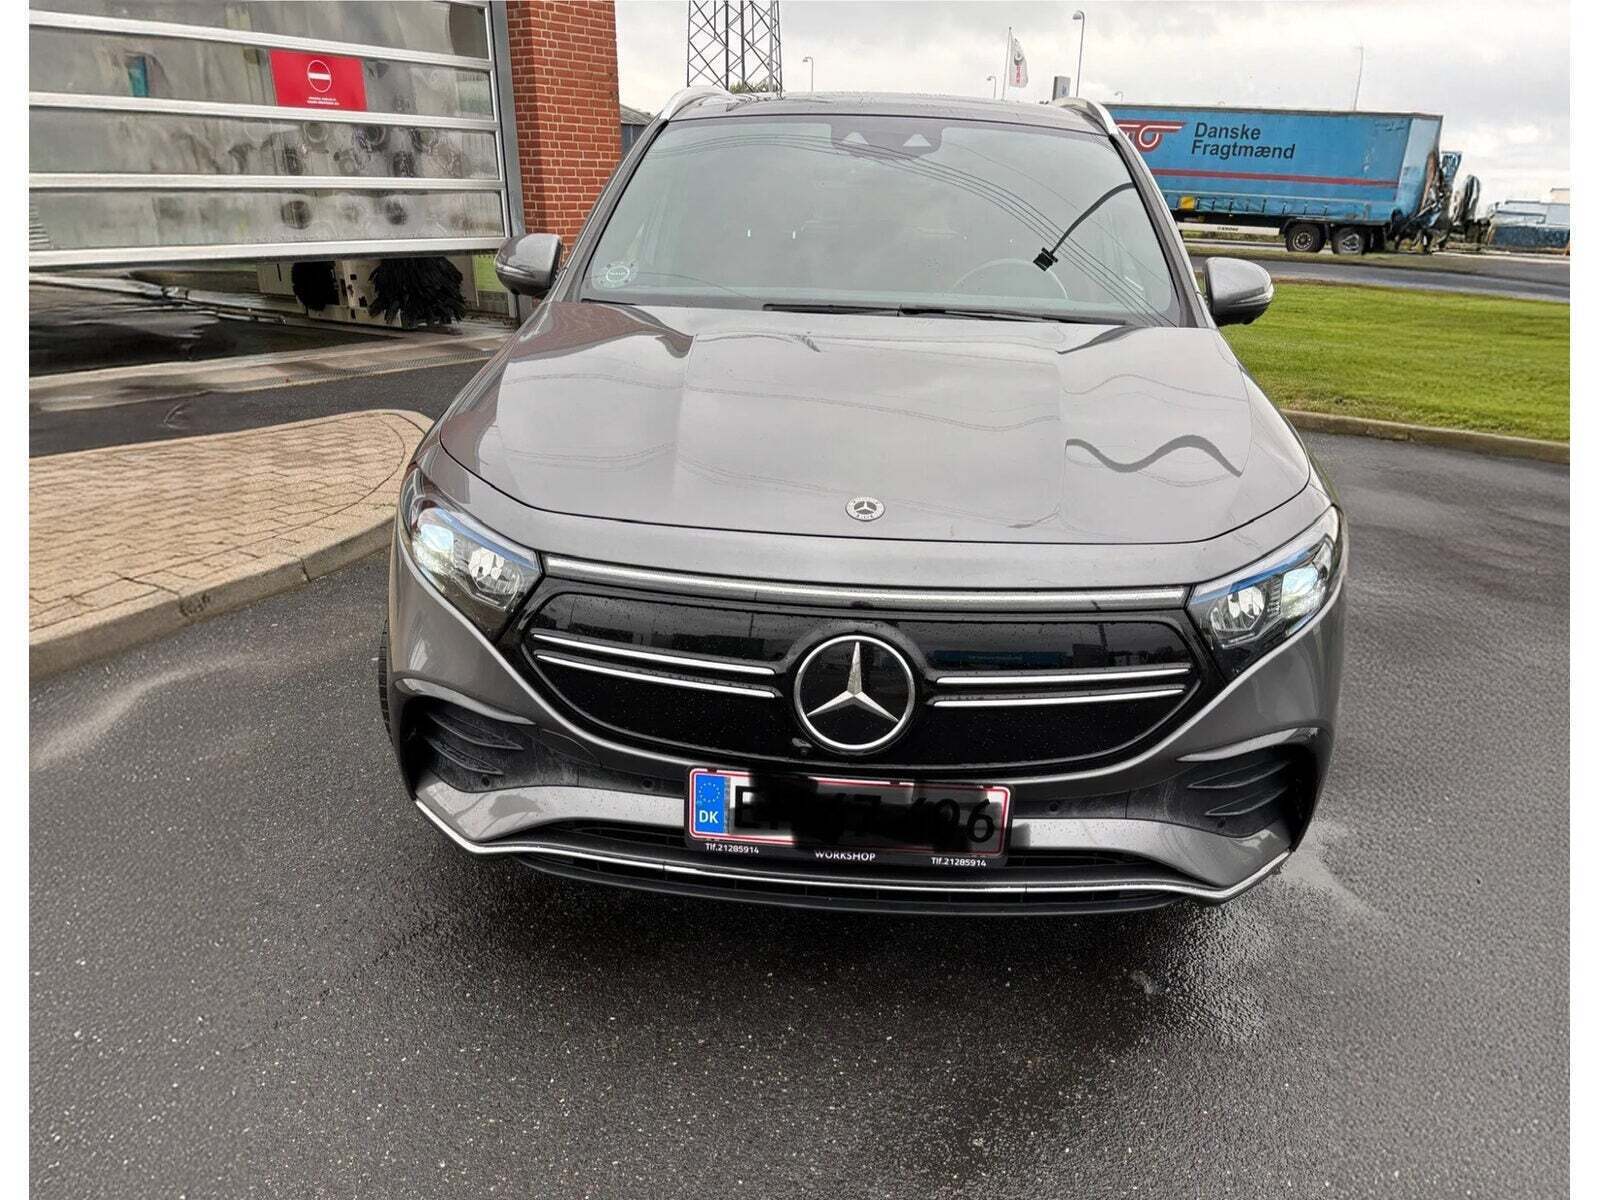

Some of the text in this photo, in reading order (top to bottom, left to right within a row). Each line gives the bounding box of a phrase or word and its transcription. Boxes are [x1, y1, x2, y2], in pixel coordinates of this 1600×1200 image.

[1194, 122, 1261, 140] Danske
[1191, 139, 1296, 160] Fragtmænd
[699, 810, 719, 824] DK
[814, 850, 876, 862] WORKSHOP
